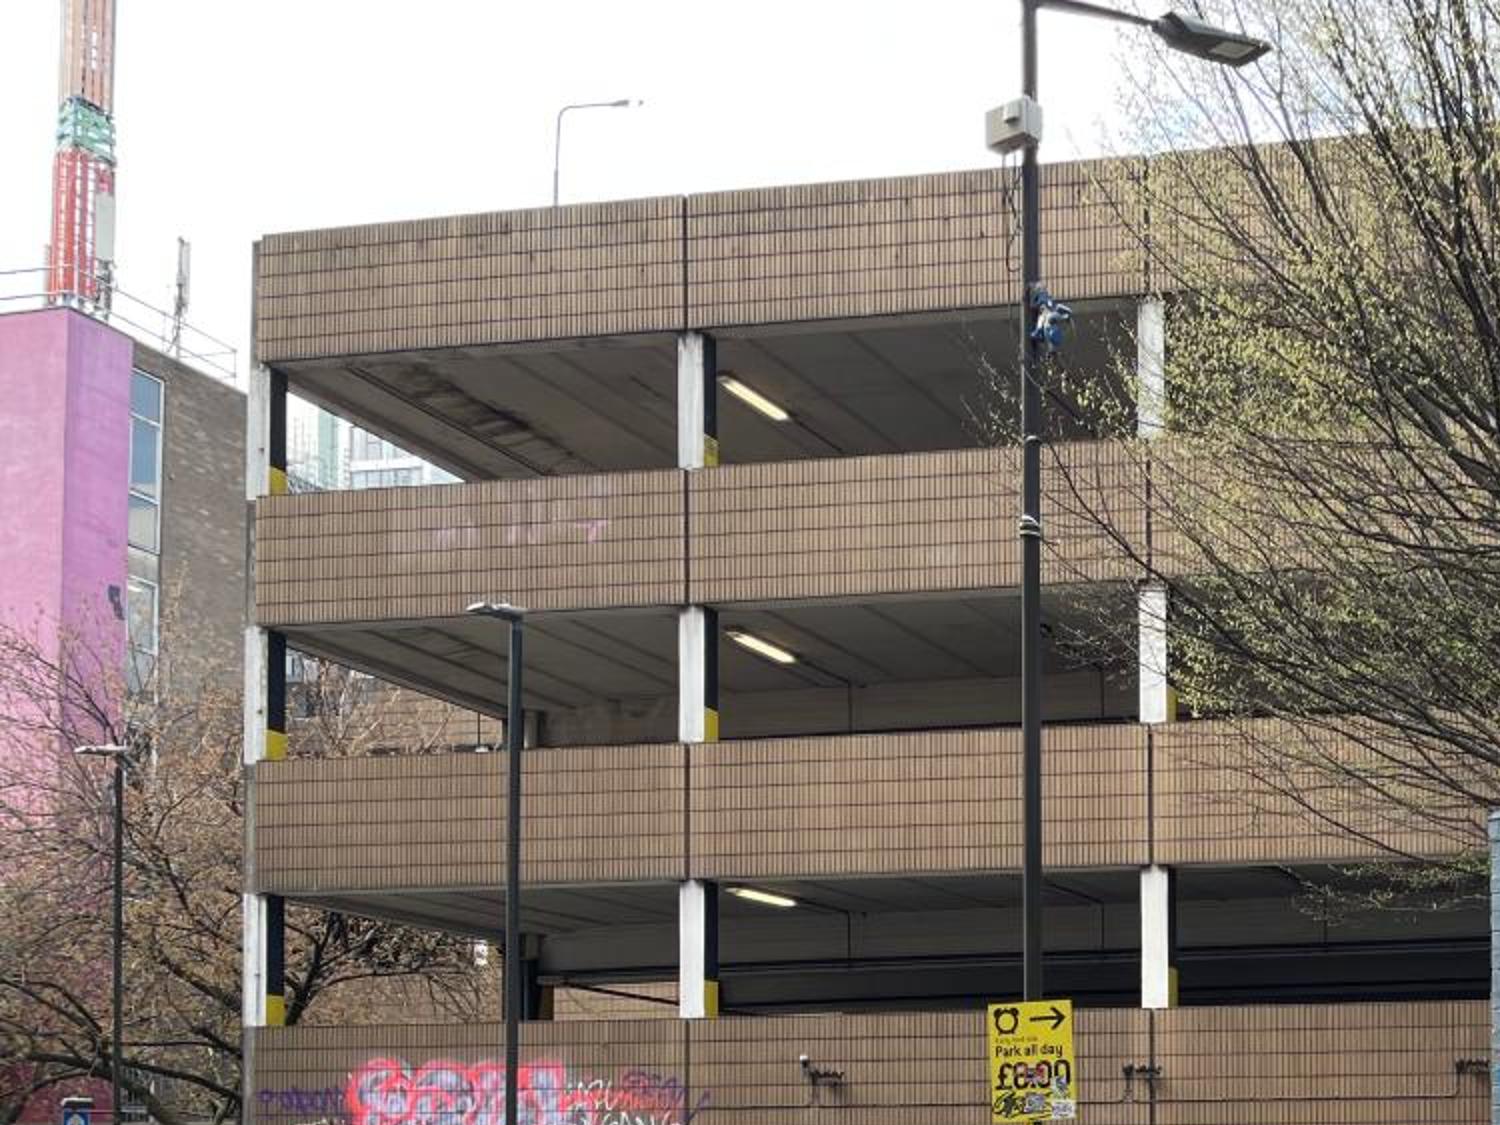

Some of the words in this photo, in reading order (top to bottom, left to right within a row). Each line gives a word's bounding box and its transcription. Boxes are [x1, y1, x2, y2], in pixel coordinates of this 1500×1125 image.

[995, 1046, 1021, 1057] Park
[1024, 1044, 1038, 1056] all
[1040, 1043, 1063, 1058] day
